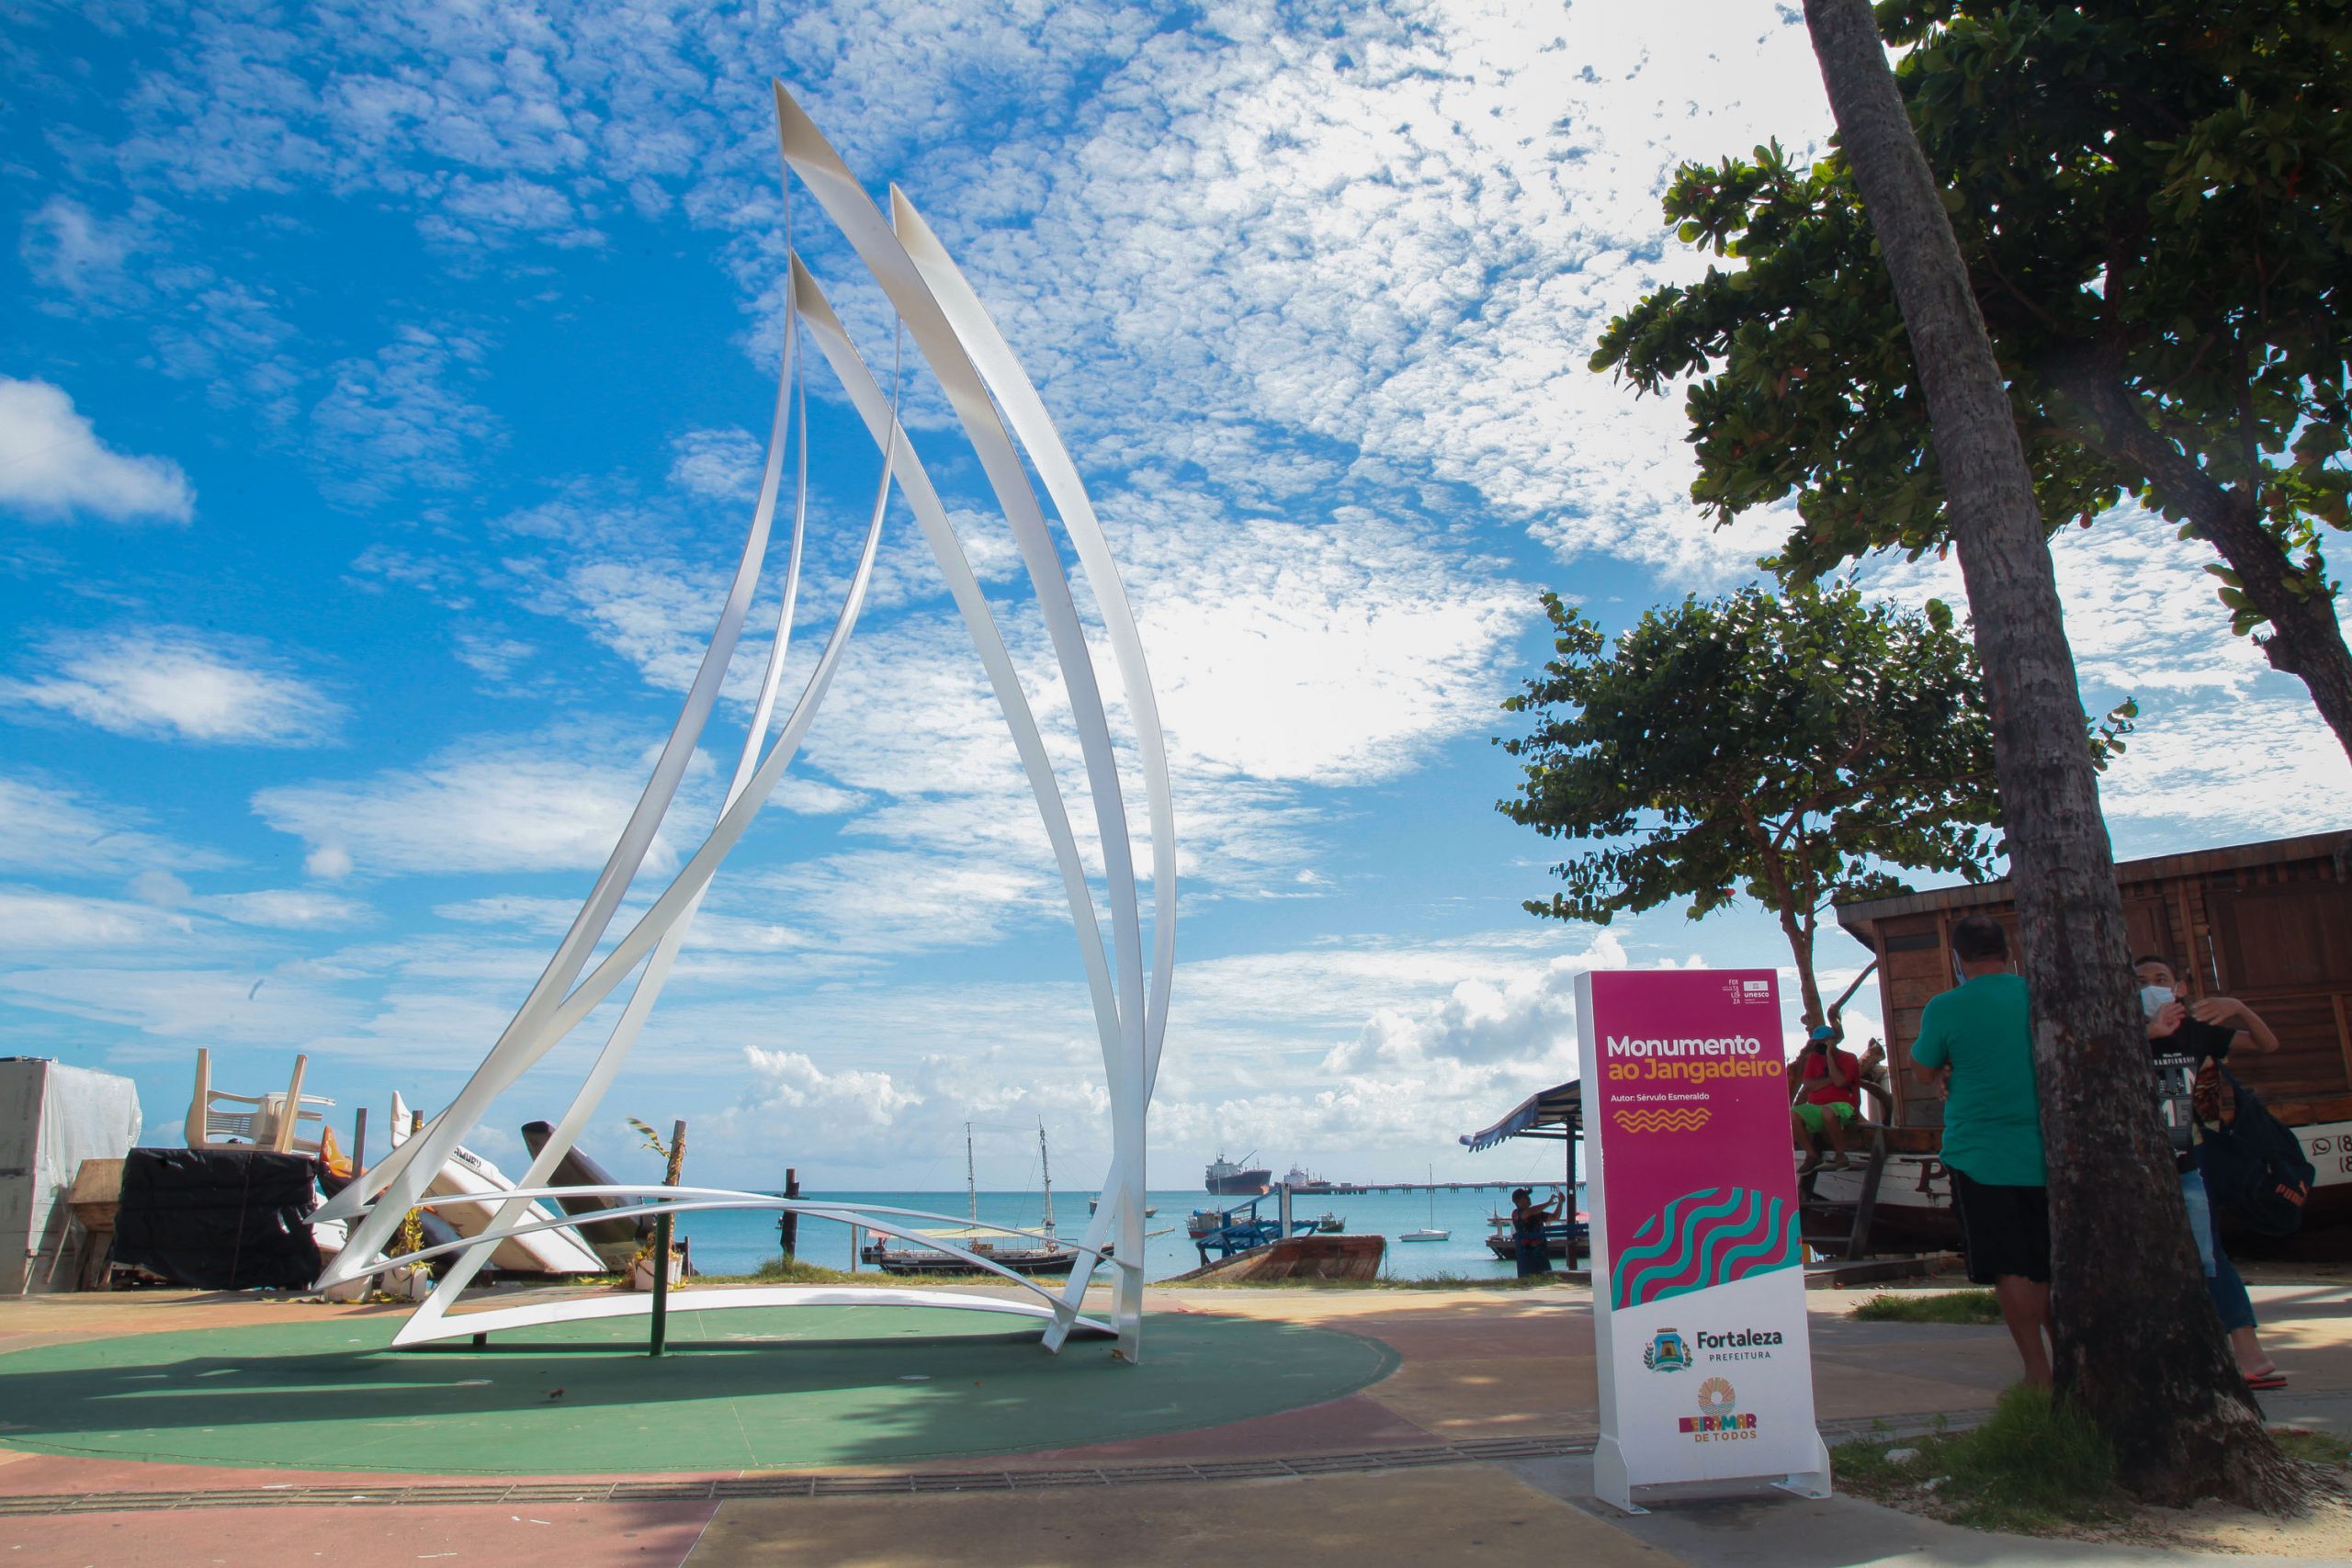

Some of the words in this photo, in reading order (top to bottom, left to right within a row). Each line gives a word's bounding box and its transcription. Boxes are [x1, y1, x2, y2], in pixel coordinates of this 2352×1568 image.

[1607, 1035, 1760, 1056] Monumento
[1609, 1063, 1640, 1080] ao
[1645, 1054, 1781, 1084] Jangadeiro
[1611, 1094, 1635, 1102] Autor:
[1636, 1093, 1667, 1101] Sérvulo
[1668, 1092, 1710, 1100] Esmeraldo
[1697, 1328, 1782, 1349] Fortaleza
[1709, 1351, 1771, 1362] PREFEITURA
[1695, 1434, 1709, 1443] DE
[1713, 1430, 1757, 1441] TODOS
